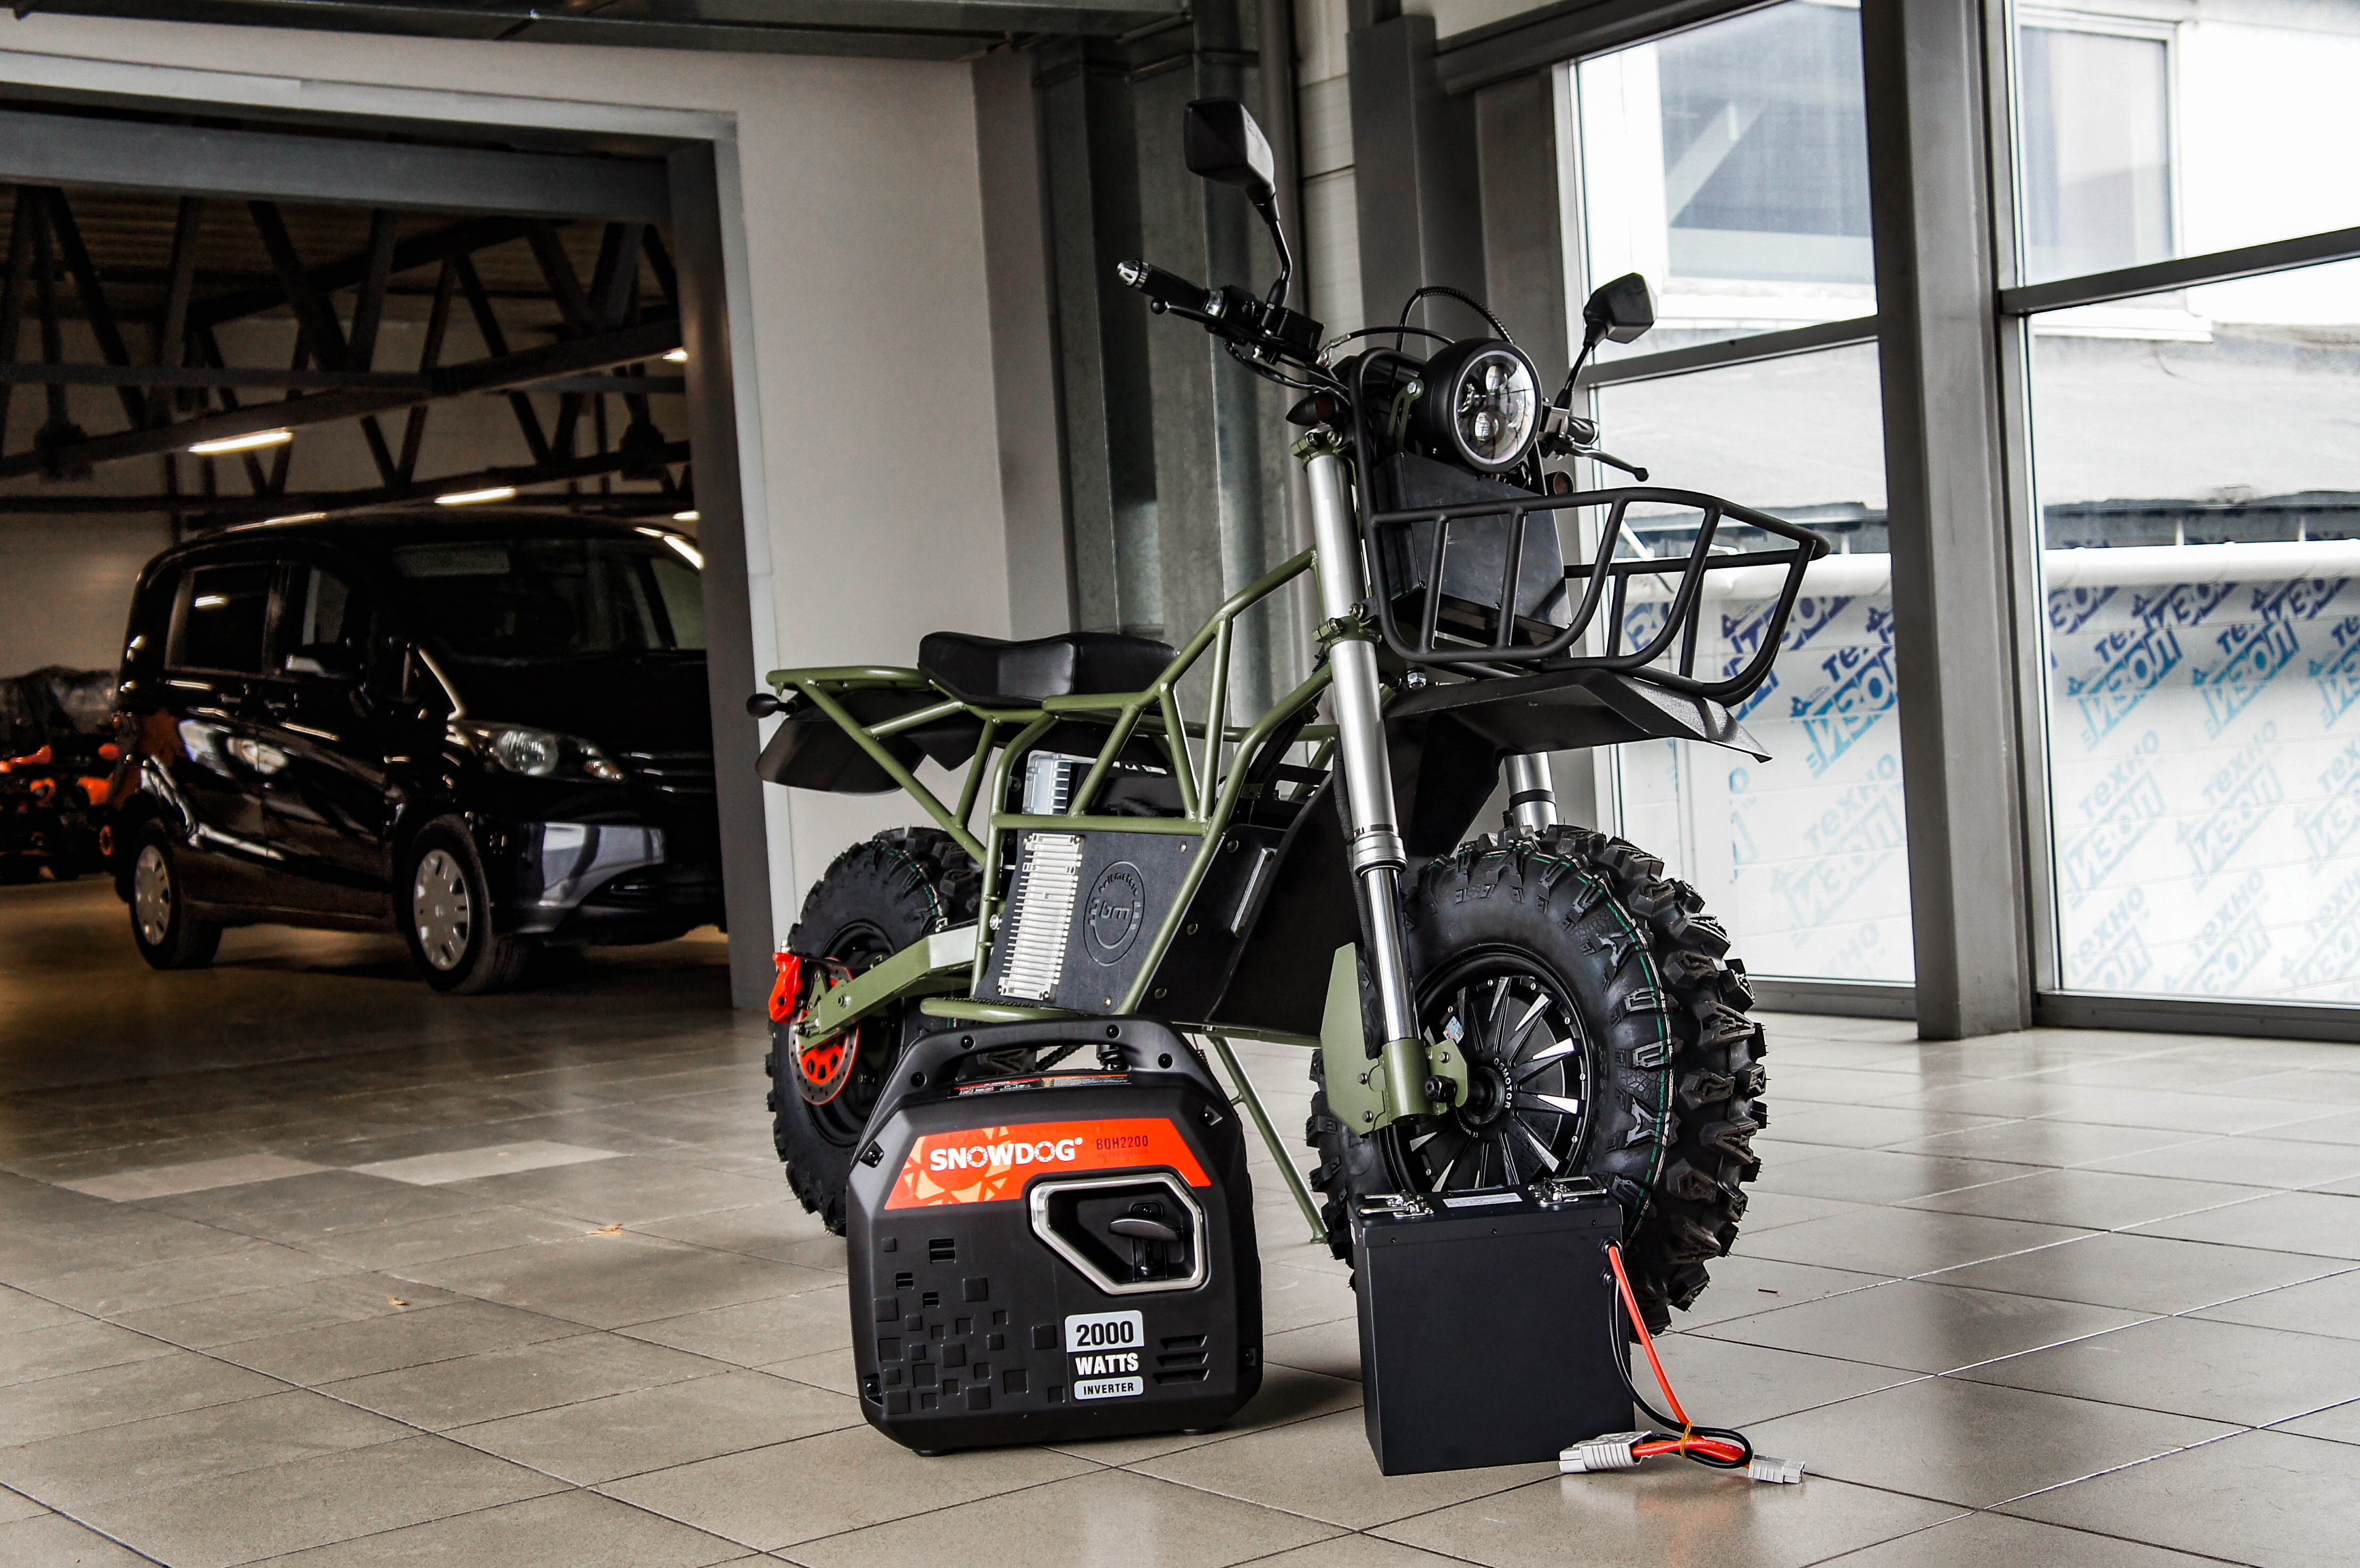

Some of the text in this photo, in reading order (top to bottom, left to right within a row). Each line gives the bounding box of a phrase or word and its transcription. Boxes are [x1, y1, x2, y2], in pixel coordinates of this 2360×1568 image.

[1096, 1136, 1149, 1150] BQH2200
[1076, 1321, 1134, 1347] 2000
[1075, 1353, 1139, 1375] WATTS
[1083, 1382, 1134, 1396] INVERTER
